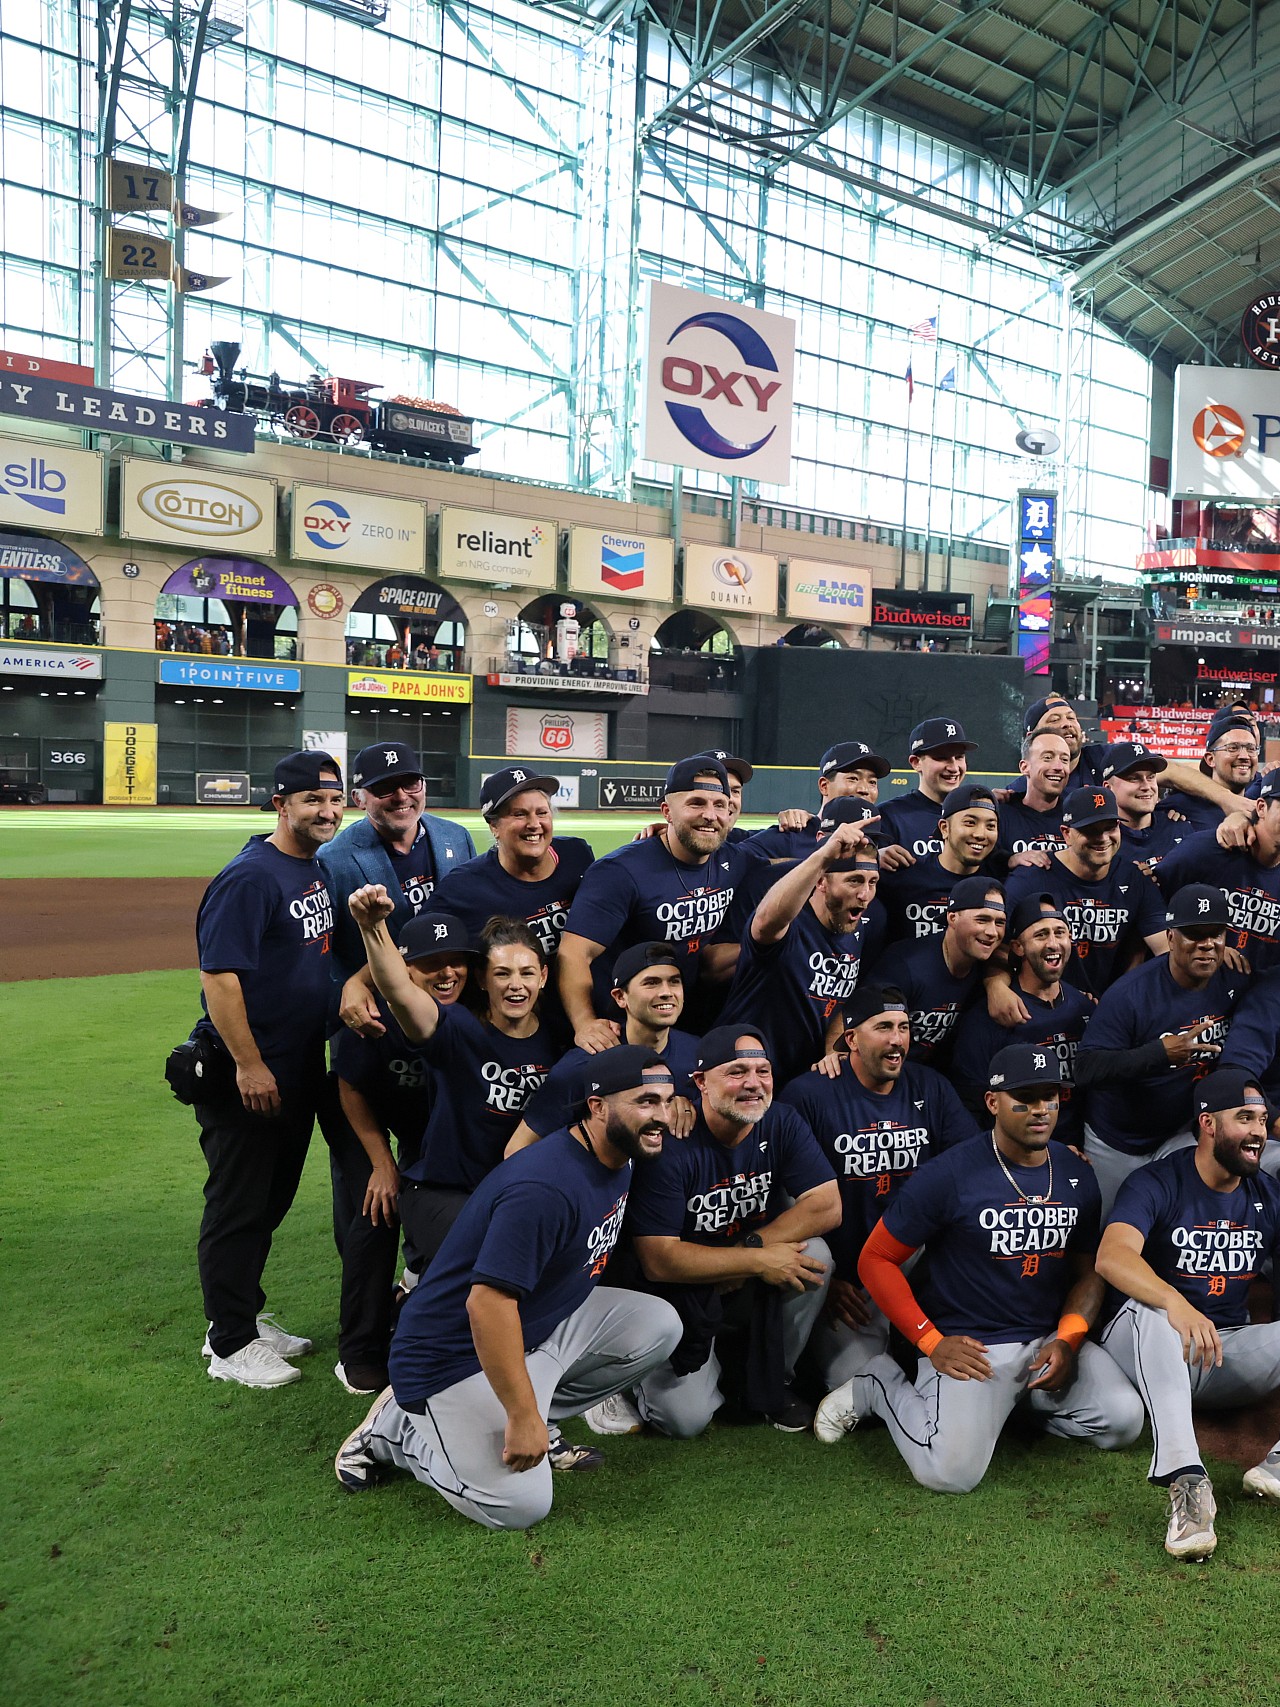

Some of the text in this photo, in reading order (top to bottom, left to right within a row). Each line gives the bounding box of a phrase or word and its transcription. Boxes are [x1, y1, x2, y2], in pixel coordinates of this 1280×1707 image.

[123, 175, 159, 201] 17
[122, 244, 157, 268] 22
[661, 355, 783, 413] OXY
[56, 392, 228, 438] LEADERS
[4, 457, 67, 493] slb
[155, 490, 244, 528] COTTON
[303, 516, 352, 534] OXY
[361, 524, 394, 539] ZERO
[457, 530, 533, 559] reliant
[602, 534, 645, 550] Chevron
[125, 564, 137, 574] 24
[456, 559, 533, 578] an NRG company
[196, 577, 209, 588] pf
[219, 572, 266, 588] planet
[1179, 572, 1234, 584] HORNITOS
[1236, 576, 1263, 585] TEQUILA
[226, 583, 274, 599] fitness
[379, 586, 443, 609] SPACE CITY
[710, 590, 753, 606] QUANTA
[797, 583, 855, 599] FREEPORT
[818, 579, 864, 608] LNG
[484, 604, 497, 613] DK
[875, 606, 971, 628] Budweiser
[630, 619, 639, 628] 27
[1171, 628, 1232, 644] impact
[3, 656, 66, 670] AMERICA
[180, 667, 285, 685] 1POINTFIVE
[1196, 664, 1278, 683] Budweiser
[351, 682, 366, 692] PAPA
[391, 682, 466, 699] PAPA JOHN'S
[515, 675, 560, 686] PROVIDING
[562, 678, 592, 688] ENERGY.
[593, 679, 628, 692] IMPROVING
[544, 718, 570, 727] PHILLIPS
[1151, 706, 1215, 721] Budweiser
[545, 730, 567, 743] 66
[1131, 733, 1198, 746] Budweiser
[51, 751, 86, 764] 366
[126, 726, 136, 795] DOGGETT
[581, 769, 598, 777] 399
[891, 778, 908, 786] 409
[621, 785, 666, 798] VERIT
[656, 887, 735, 922] OCTOBER
[664, 908, 729, 942] READY
[834, 1128, 930, 1155] OCTOBER
[844, 1149, 921, 1177] READY
[687, 1172, 772, 1214] OCTOBER
[694, 1192, 770, 1233] READY
[979, 1206, 1079, 1230] OCTOBER
[990, 1227, 1072, 1256] READY
[1171, 1226, 1264, 1250] OCTOBER
[1175, 1248, 1258, 1275] READY
